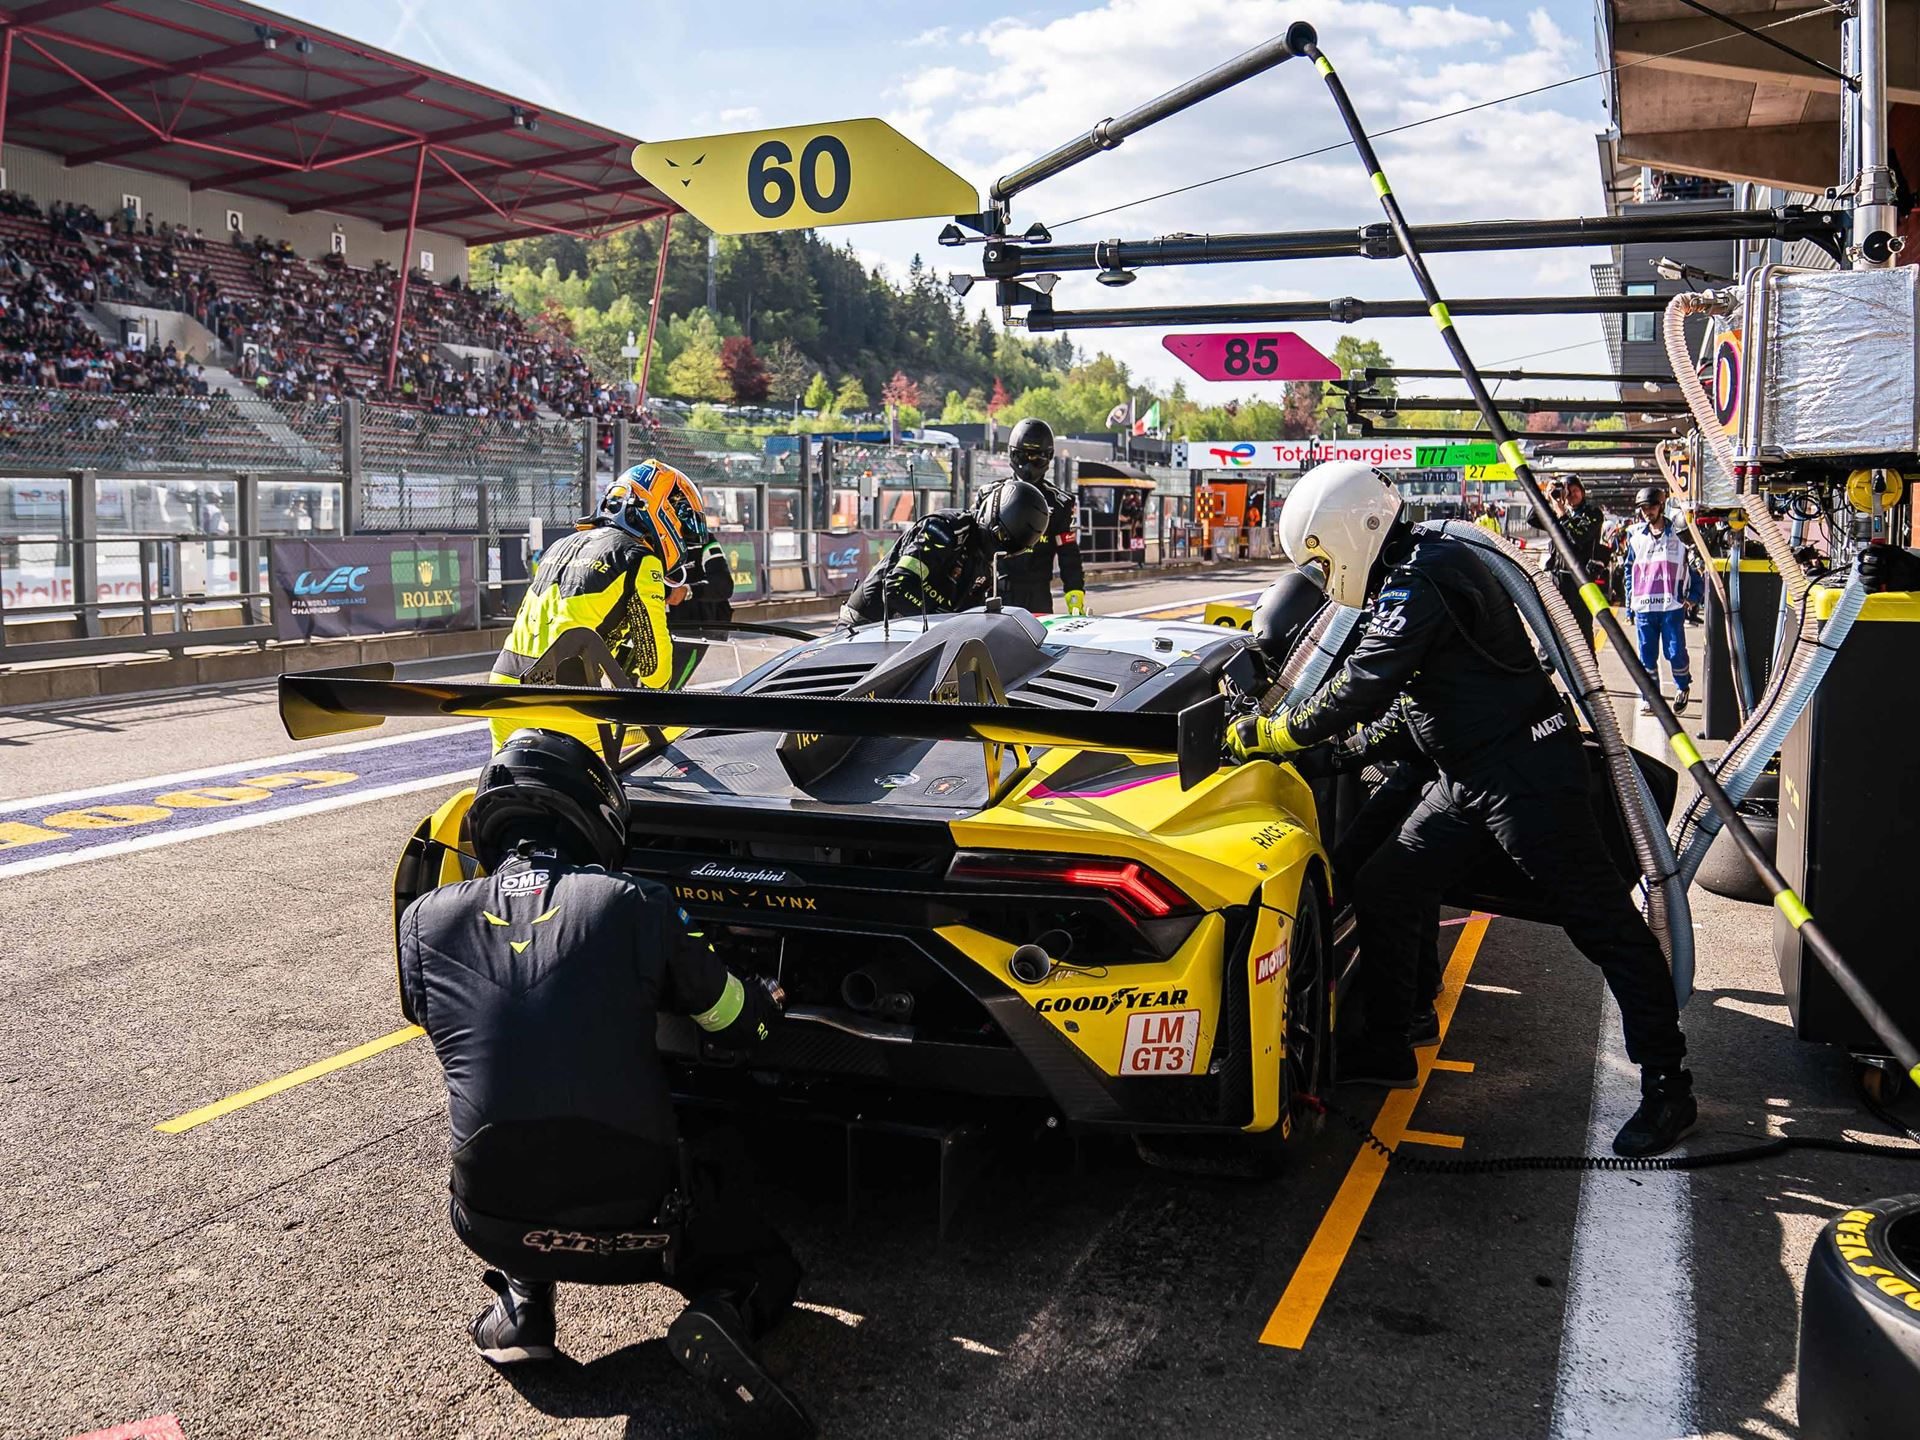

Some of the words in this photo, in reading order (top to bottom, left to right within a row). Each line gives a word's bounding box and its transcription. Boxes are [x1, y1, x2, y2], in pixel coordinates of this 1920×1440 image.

[747, 134, 852, 219] 60
[1223, 338, 1279, 376] 85
[1272, 444, 1413, 465] TotalEnergies
[1418, 448, 1448, 465] 777
[1469, 465, 1487, 479] 27
[293, 565, 369, 595] WEC
[402, 590, 454, 609] ROLEX
[1292, 705, 1314, 726] IRON
[501, 872, 550, 889] OMP
[690, 862, 787, 883] Lamborghini
[675, 886, 724, 902] IRON
[766, 894, 817, 910] LYNX
[1035, 988, 1189, 1013] GOODYEAR
[1142, 1016, 1183, 1044] LM
[1131, 1046, 1185, 1072] GT3
